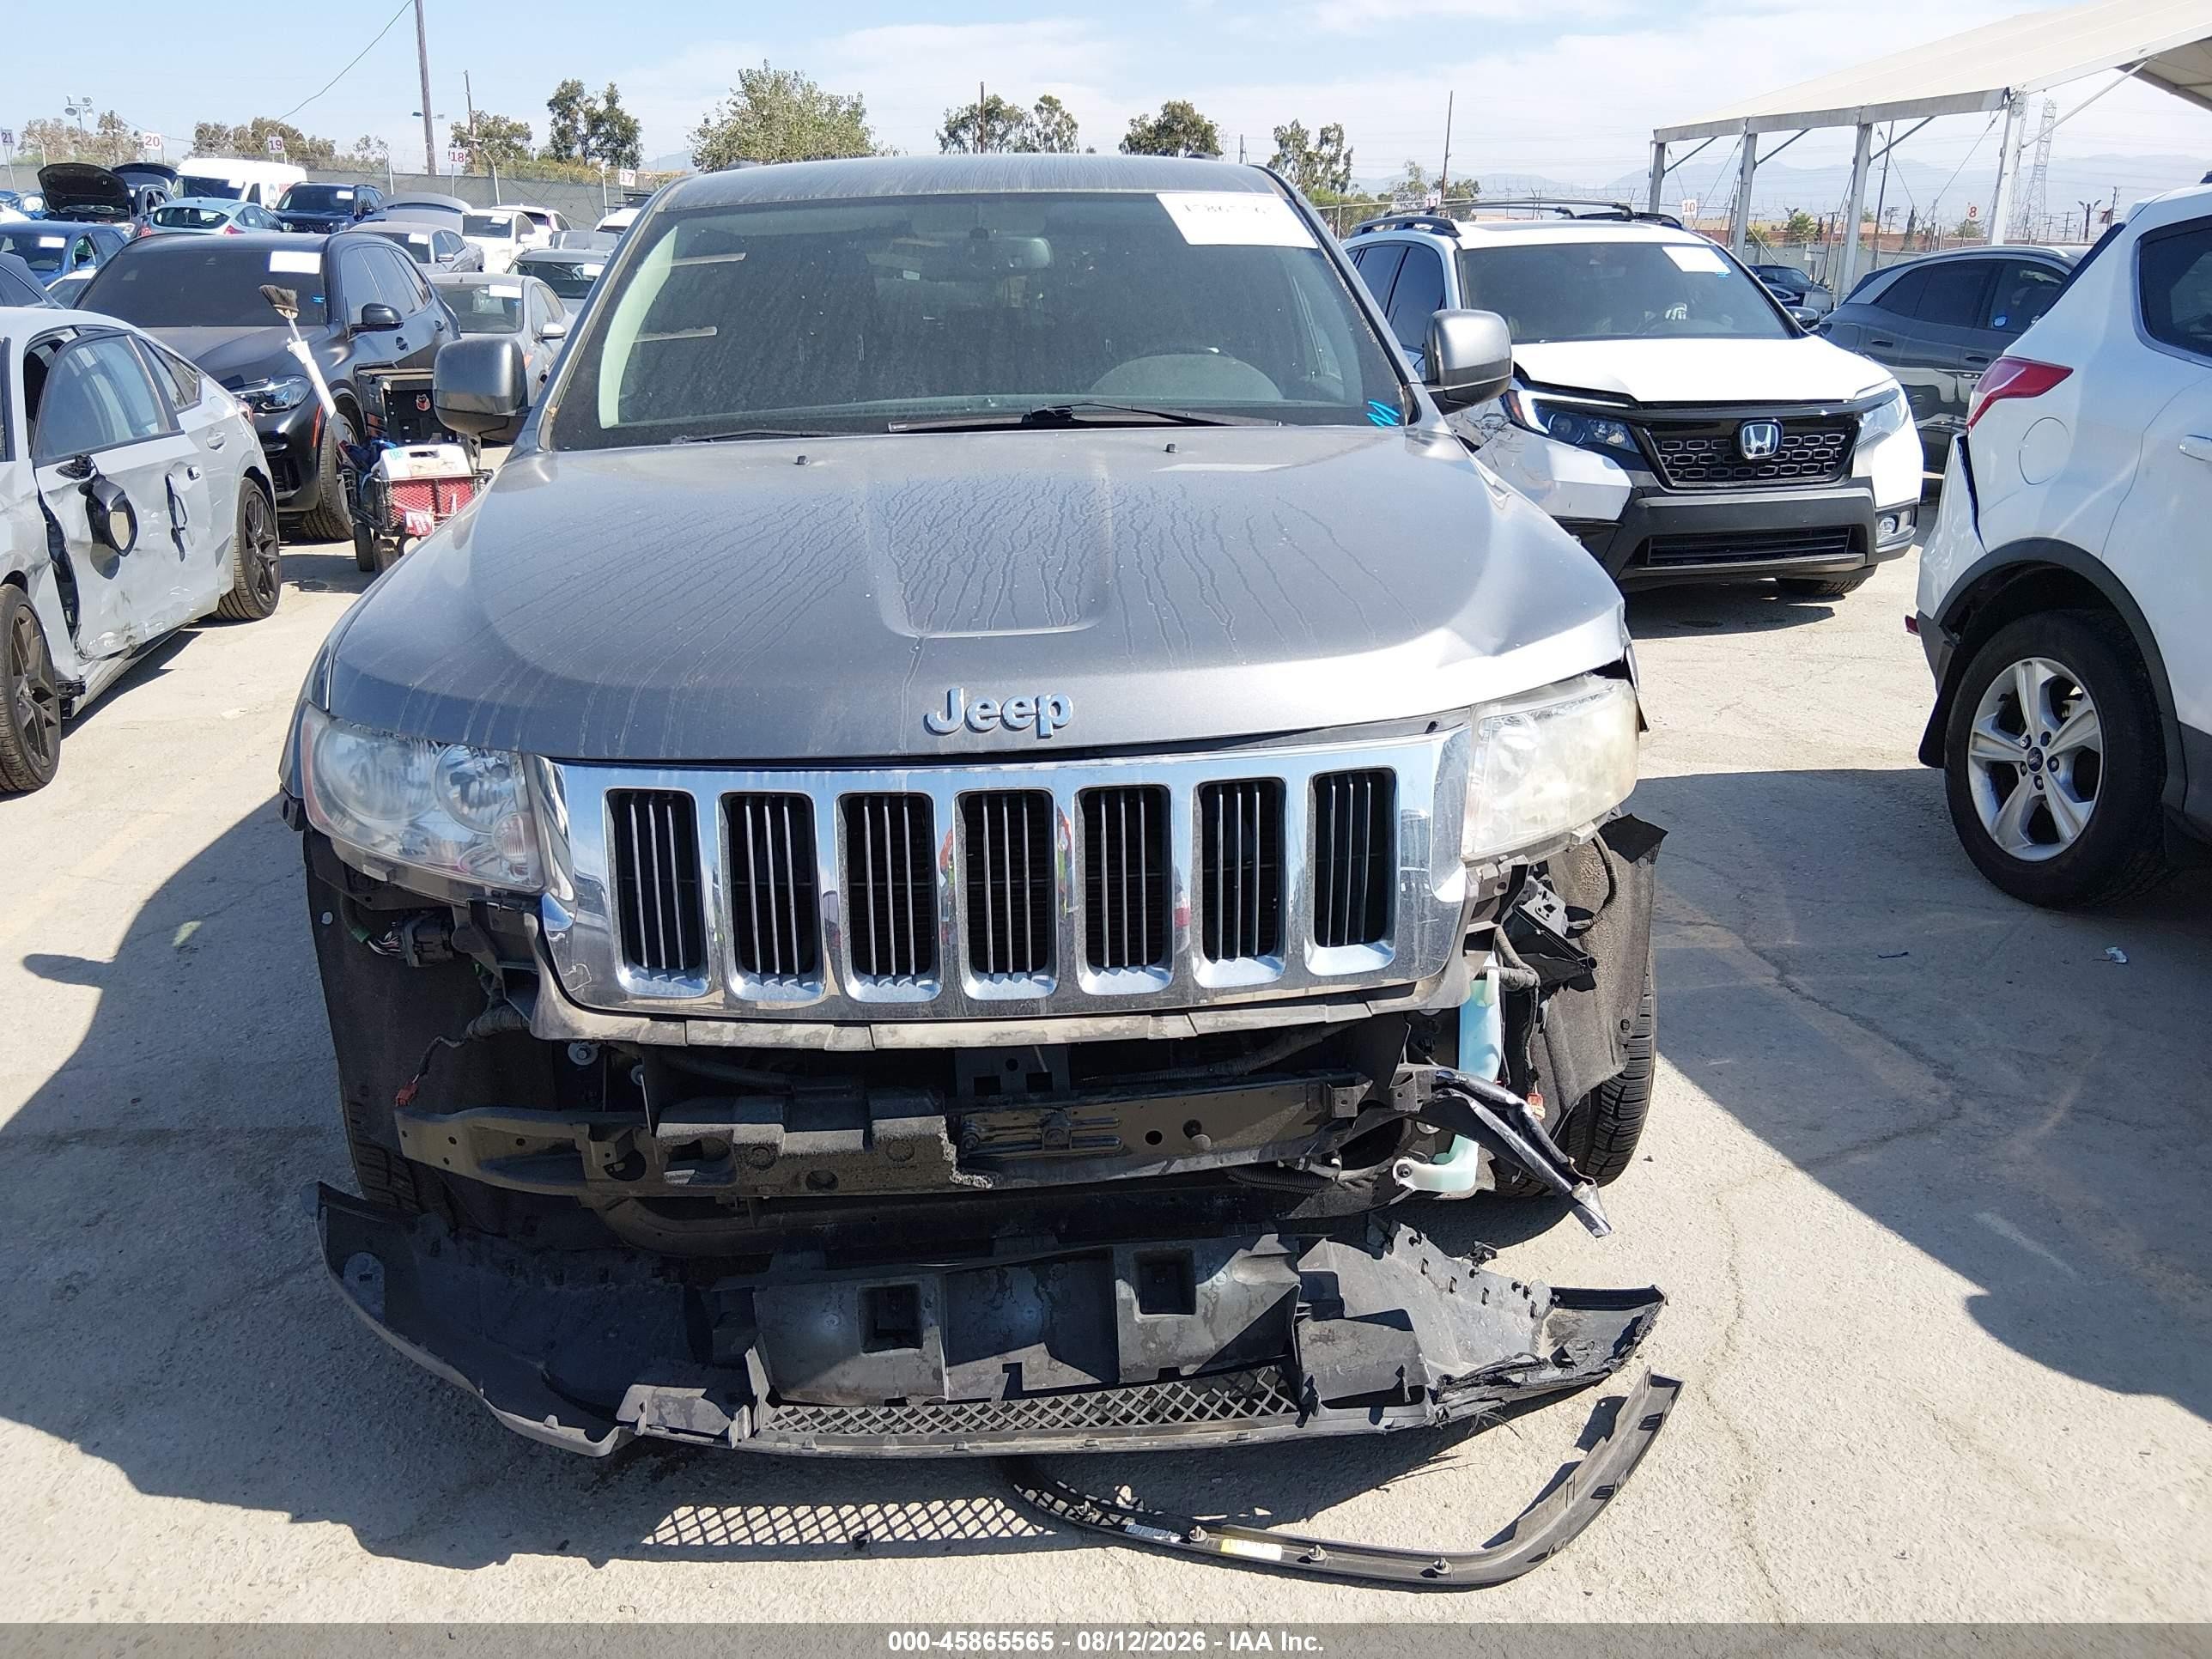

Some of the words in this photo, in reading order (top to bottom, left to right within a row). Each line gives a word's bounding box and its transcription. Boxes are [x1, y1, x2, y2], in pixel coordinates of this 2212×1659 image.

[1, 131, 14, 143] 21
[144, 135, 161, 148] 20
[269, 139, 283, 151] 19
[451, 151, 465, 163] 18
[620, 172, 634, 183] 17
[1684, 202, 1695, 212] 10
[1968, 206, 1978, 218] 8
[923, 687, 1073, 739] Jeep
